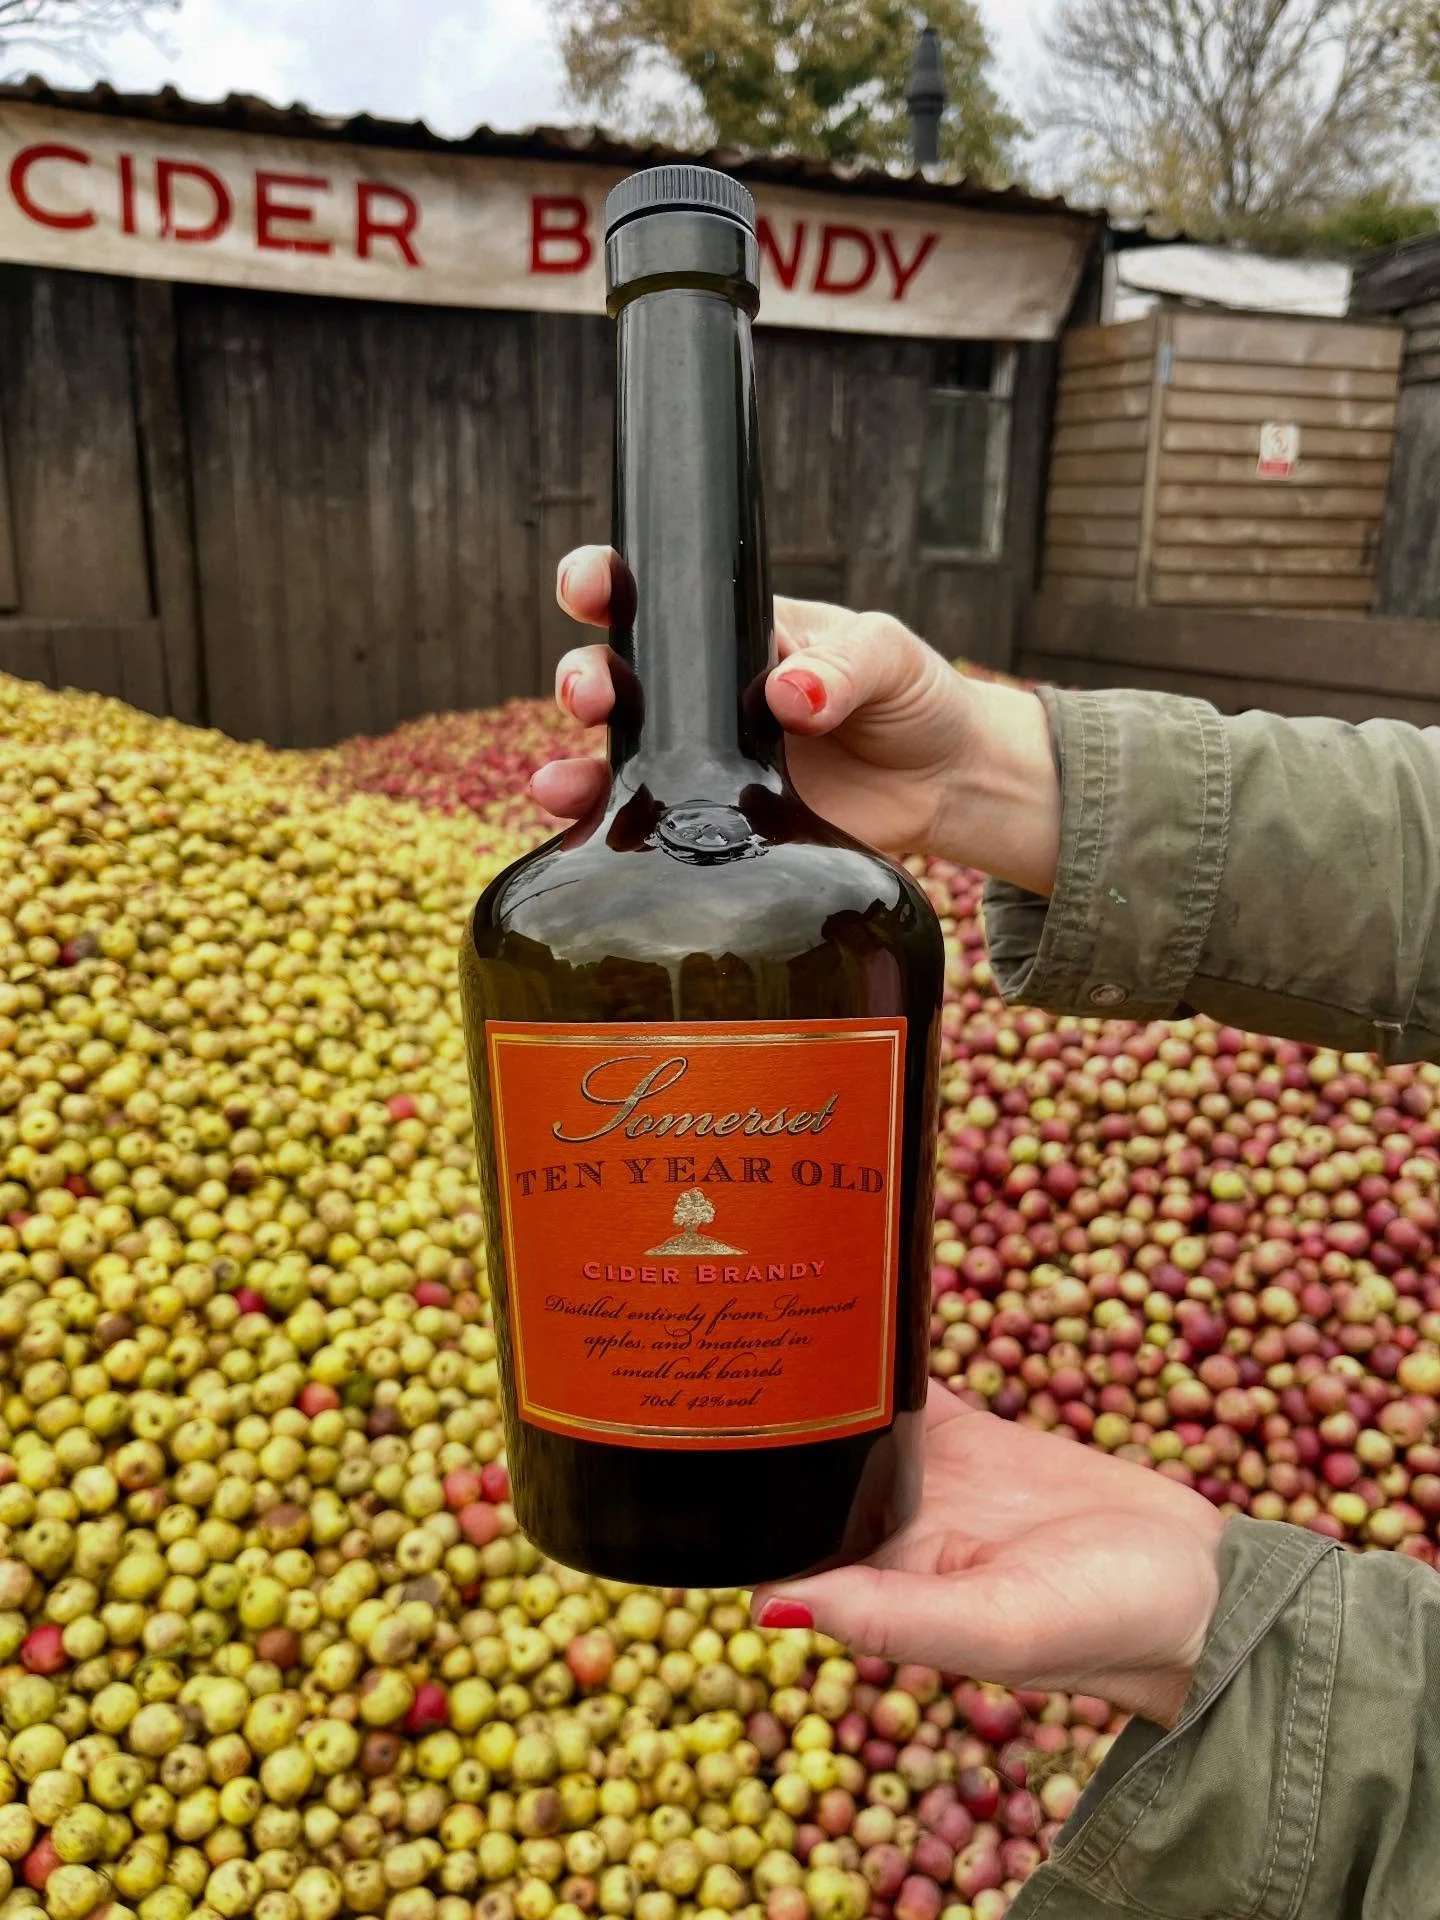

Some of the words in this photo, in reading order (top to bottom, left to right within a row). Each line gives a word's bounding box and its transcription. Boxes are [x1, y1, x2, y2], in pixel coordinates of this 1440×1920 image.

[8, 142, 423, 268] CIDER
[529, 194, 940, 301] BNDY
[552, 1055, 839, 1143] Somerset
[516, 1160, 606, 1197] TEN
[622, 1156, 773, 1185] YEAR
[791, 1159, 884, 1194] OLD
[582, 1261, 680, 1285] CIDER
[696, 1260, 825, 1284] BRANDY
[544, 1294, 627, 1320] Distilled
[627, 1303, 706, 1337] entirely
[704, 1297, 765, 1335] from
[765, 1294, 859, 1322] Somerset
[652, 1328, 693, 1350] and
[698, 1328, 791, 1350] matured
[788, 1332, 812, 1346] in
[611, 1356, 690, 1379] small
[674, 1356, 720, 1380] oak
[716, 1351, 784, 1379] barrels
[640, 1389, 684, 1408] 70cl
